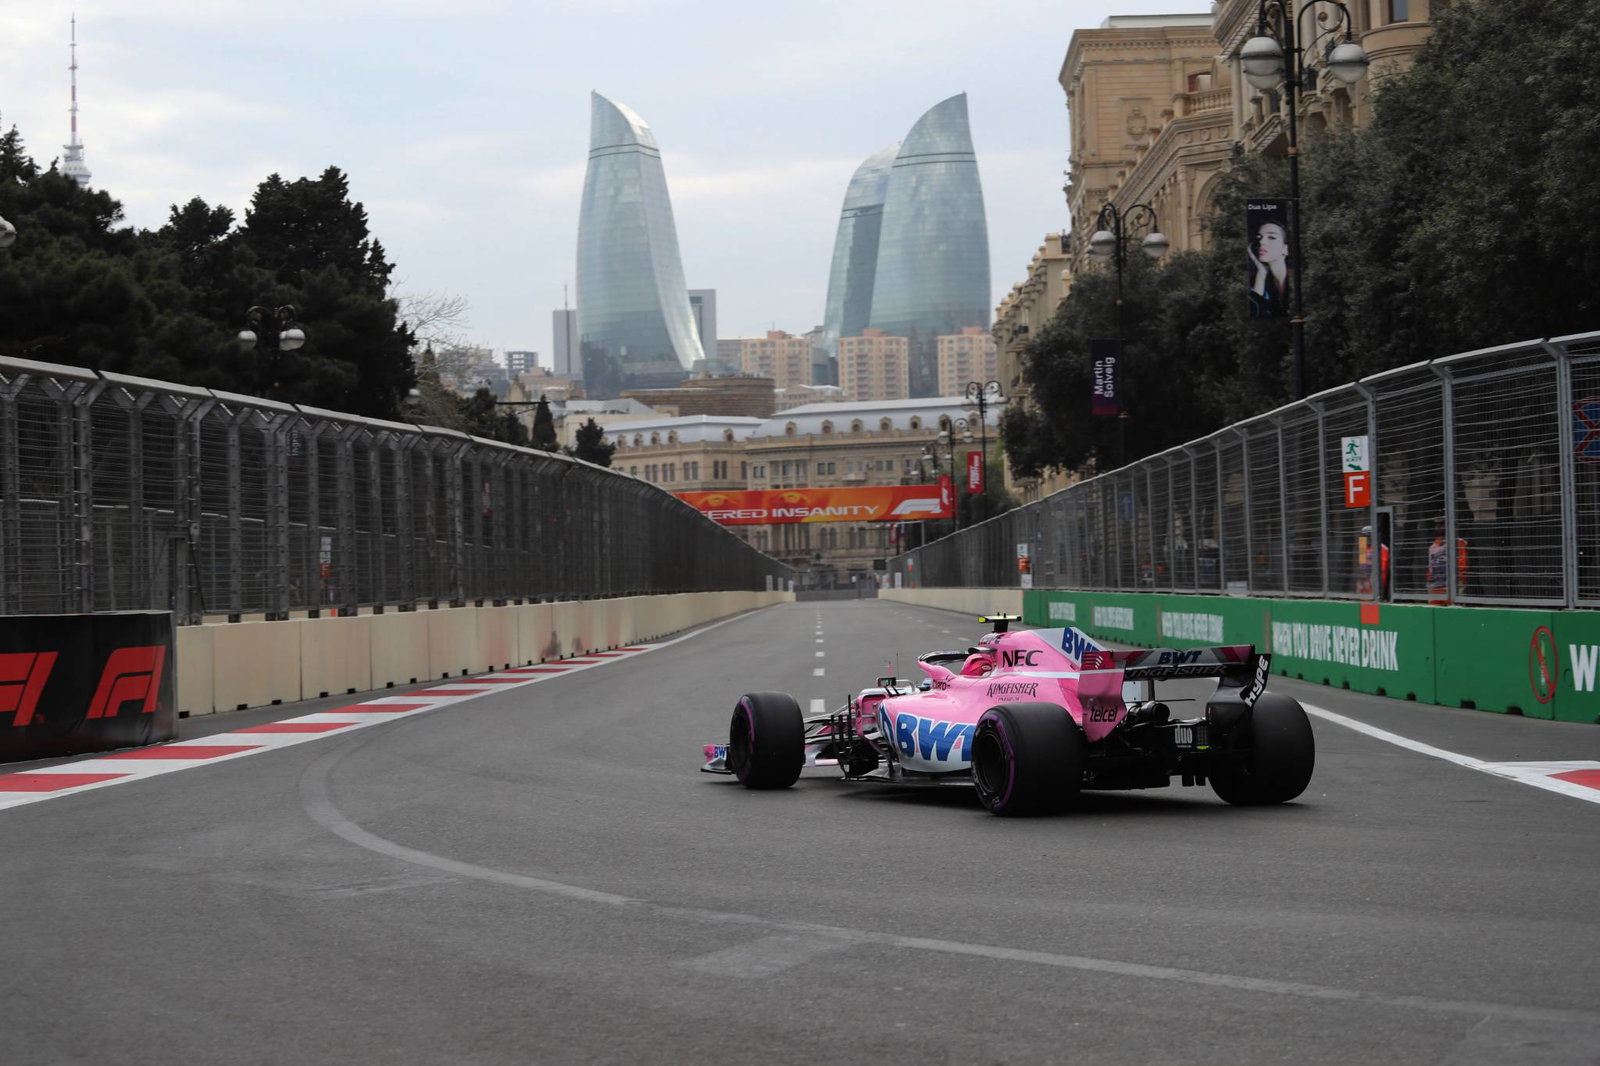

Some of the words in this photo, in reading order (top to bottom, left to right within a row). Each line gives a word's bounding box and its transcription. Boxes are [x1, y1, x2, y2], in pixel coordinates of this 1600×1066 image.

[1094, 360, 1104, 395] Martin
[1104, 356, 1116, 398] Solveig
[1348, 474, 1366, 504] F
[772, 505, 879, 518] INSANITY
[1157, 650, 1203, 665] BWT
[1332, 625, 1361, 667] NEVER
[1361, 629, 1399, 671] DRINK
[1002, 649, 1043, 668] NEC
[986, 682, 1039, 698] KINGFISHER
[1244, 655, 1269, 707] HYPE
[1090, 705, 1118, 723] telcel
[1174, 725, 1193, 744] duo
